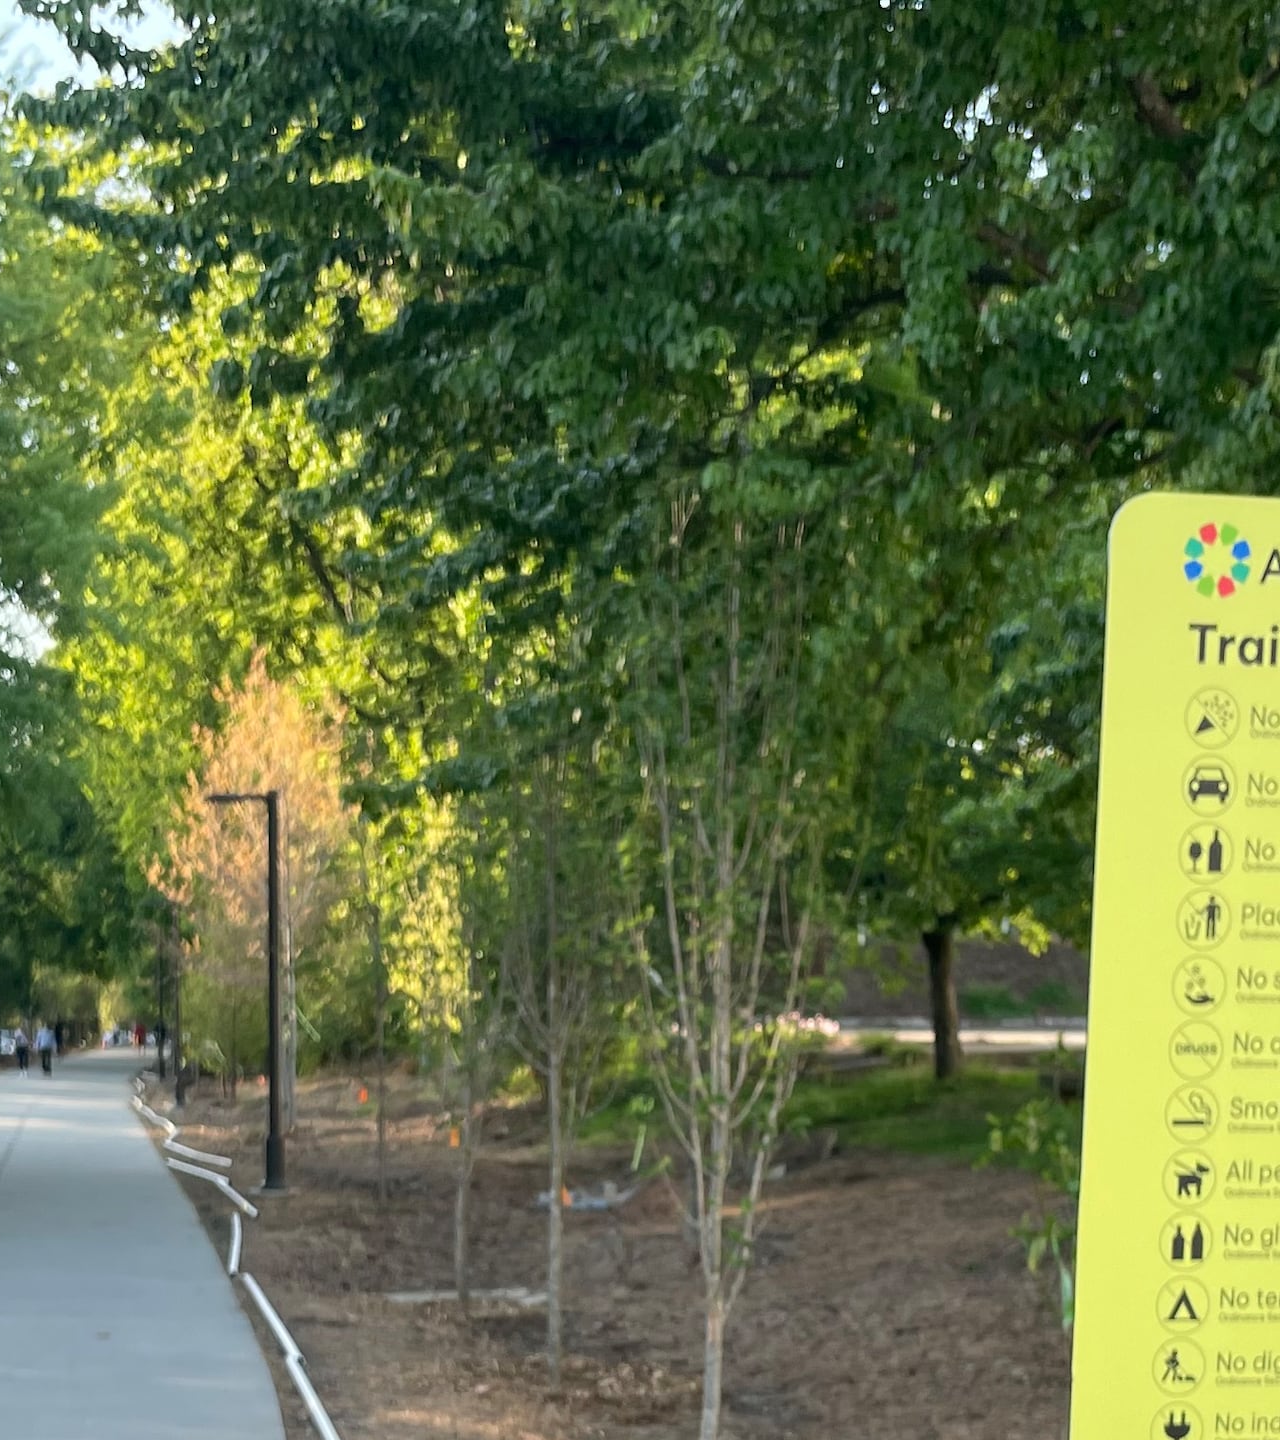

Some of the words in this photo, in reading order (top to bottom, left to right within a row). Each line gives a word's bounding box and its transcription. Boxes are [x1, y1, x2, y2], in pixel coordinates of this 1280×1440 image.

[1250, 705, 1280, 729] No
[1246, 773, 1278, 796] No
[1244, 838, 1275, 861] No
[1236, 968, 1268, 990] No
[1232, 1032, 1264, 1055] No
[1225, 1160, 1253, 1184] All
[1223, 1224, 1254, 1246] No
[1219, 1287, 1249, 1309] No
[1216, 1351, 1246, 1374] No
[1214, 1413, 1245, 1434] No
